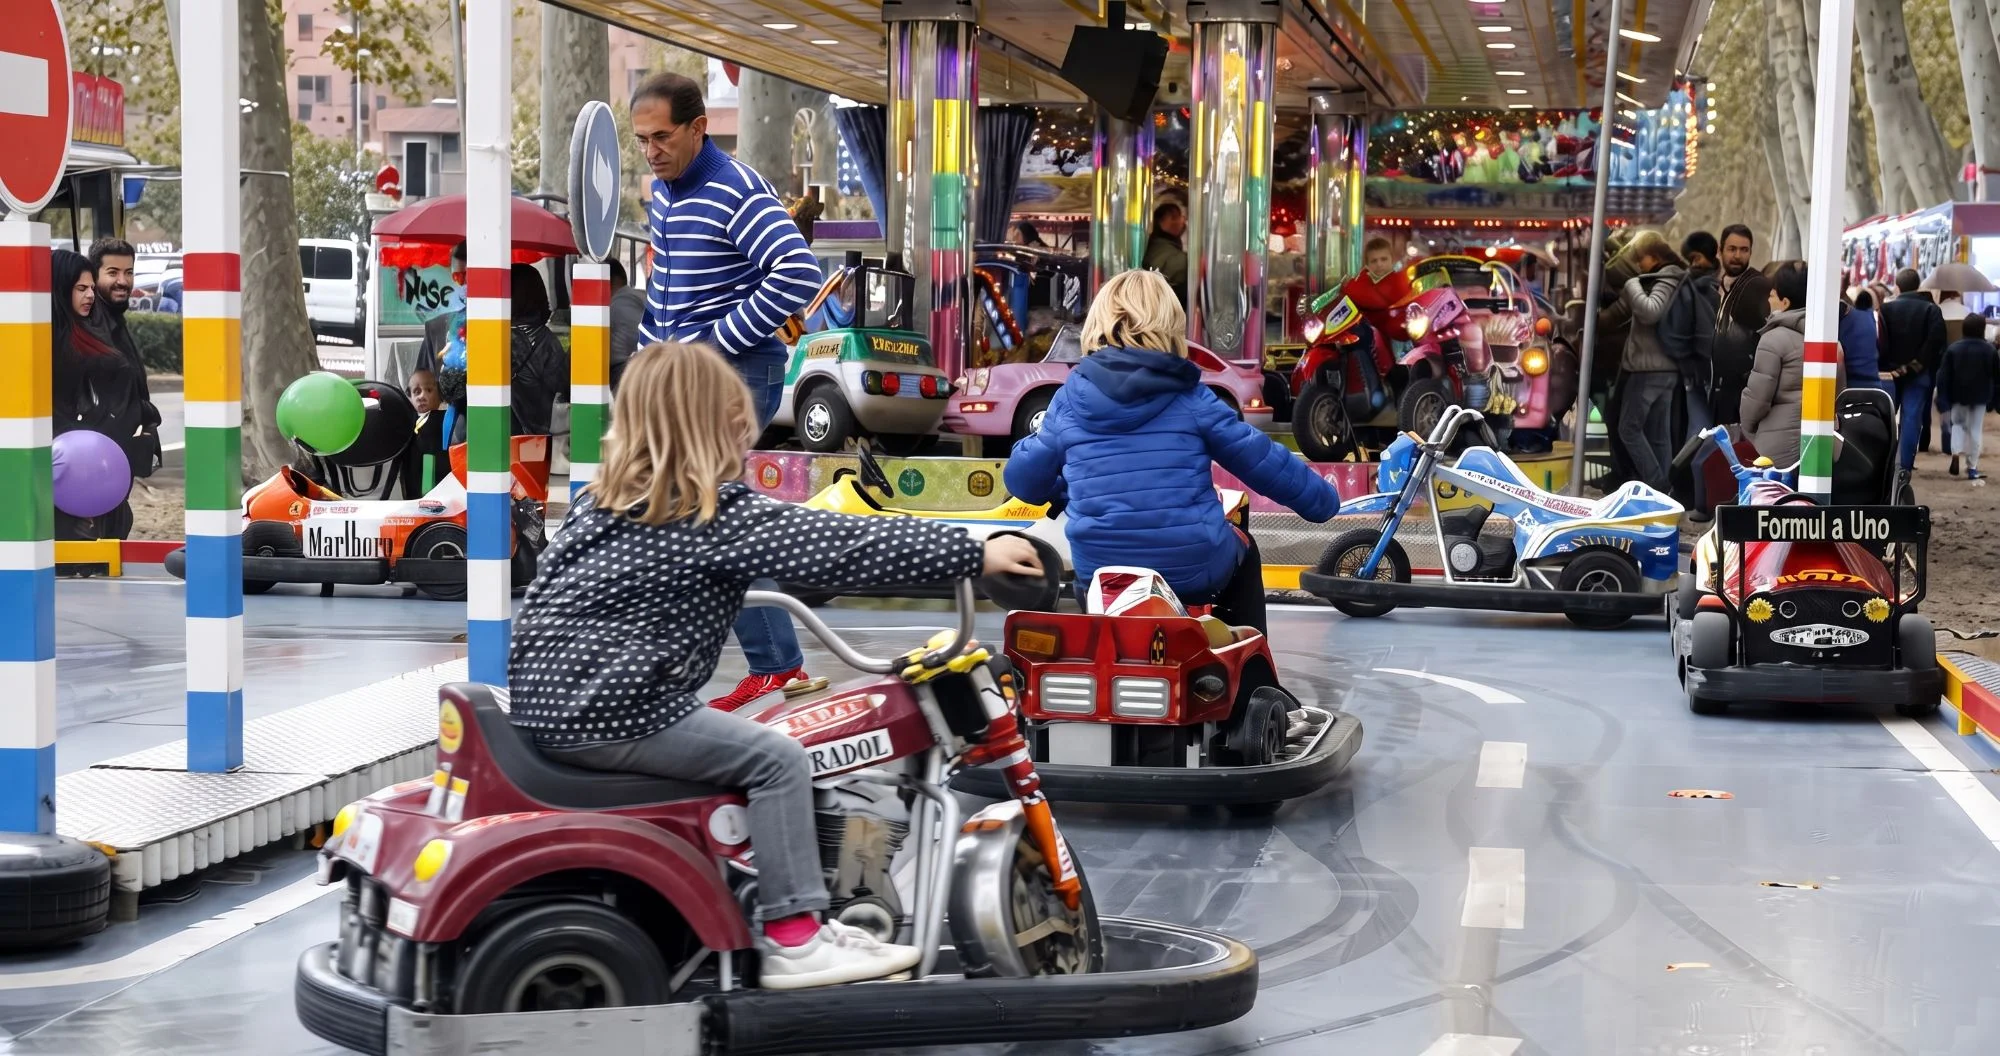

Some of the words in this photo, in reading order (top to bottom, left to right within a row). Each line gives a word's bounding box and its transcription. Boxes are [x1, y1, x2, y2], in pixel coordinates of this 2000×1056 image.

[309, 520, 393, 558] Marlboro
[1757, 510, 1825, 540] Formul
[1831, 517, 1844, 540] a
[1850, 510, 1890, 540] Uno
[808, 735, 889, 773] RADOL
